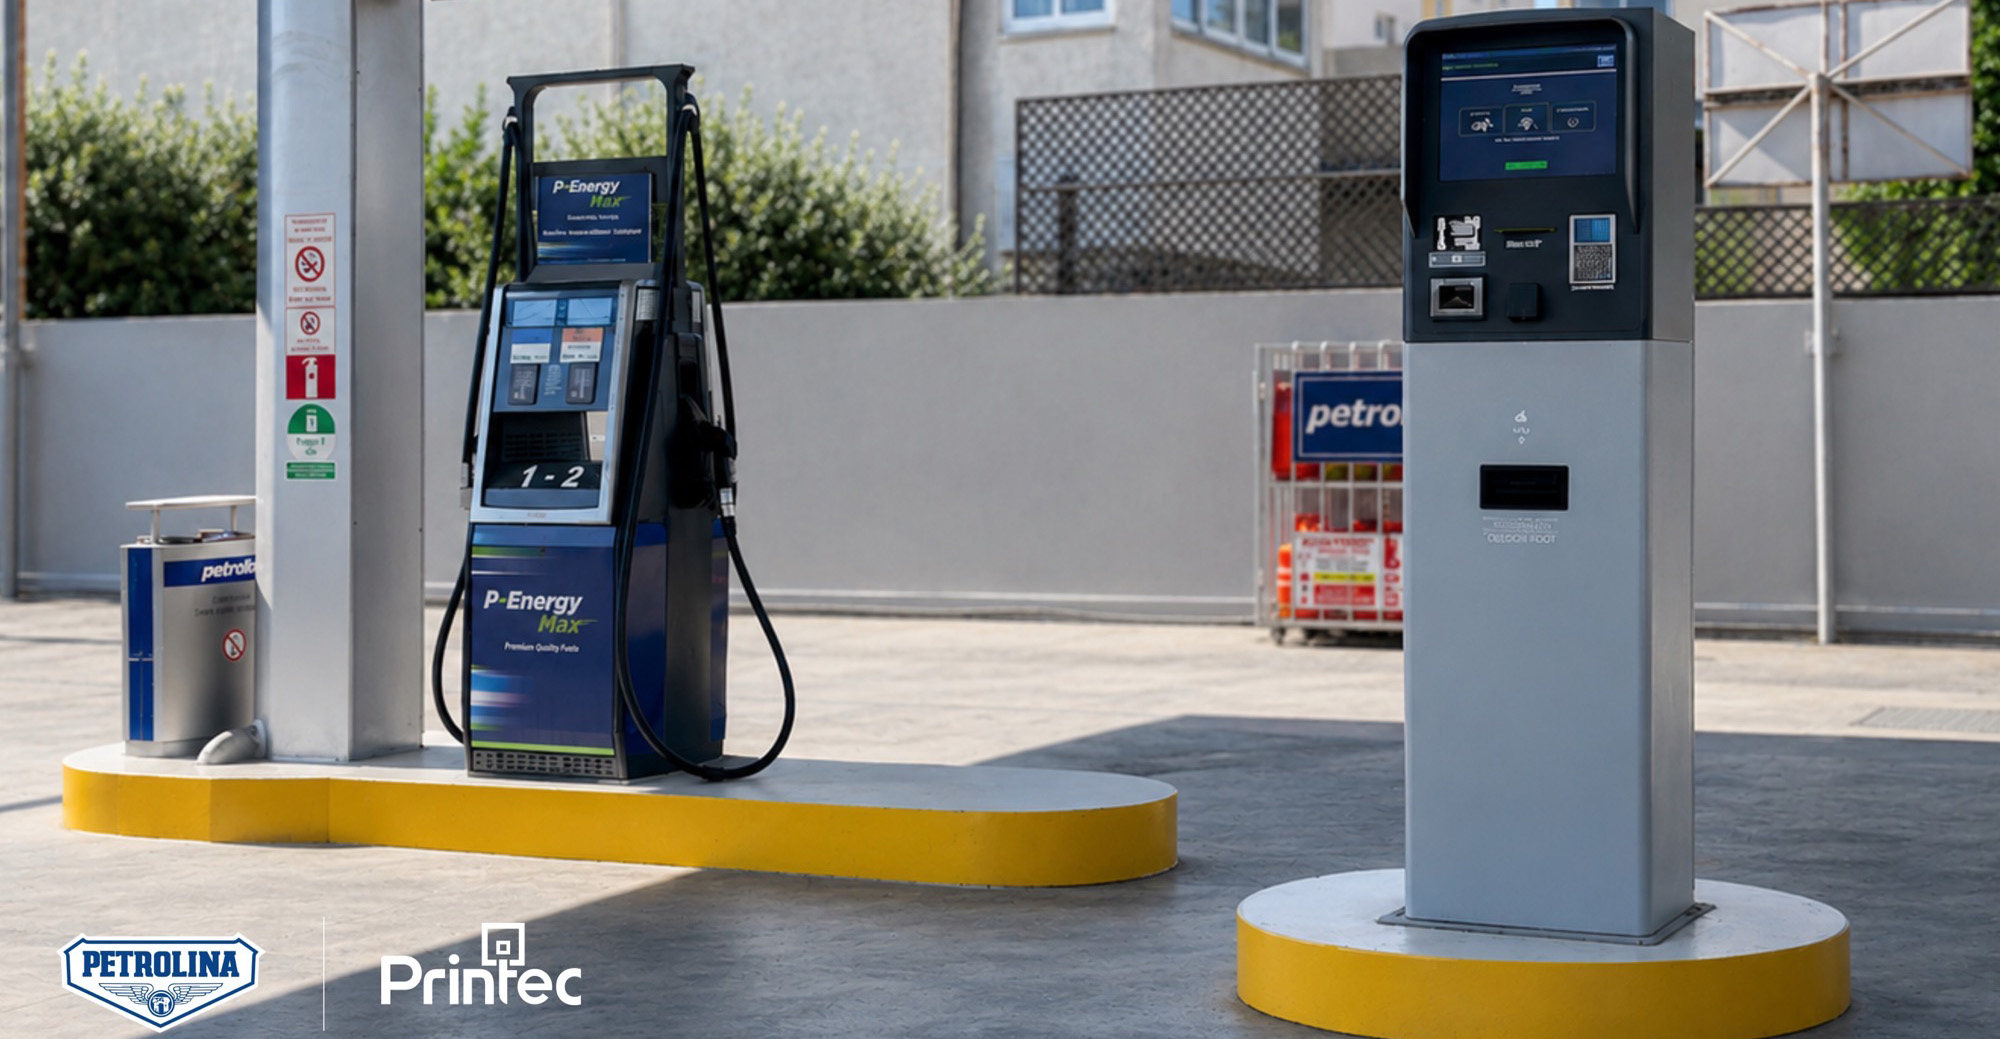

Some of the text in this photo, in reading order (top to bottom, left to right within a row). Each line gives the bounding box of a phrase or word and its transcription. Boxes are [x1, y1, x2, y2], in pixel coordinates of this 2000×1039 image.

[552, 179, 621, 195] P-Energy
[1305, 398, 1403, 435] petro
[521, 465, 538, 488] 1
[560, 465, 585, 488] 2
[483, 589, 583, 616] P-Energy
[537, 614, 584, 634] Max
[504, 641, 534, 652] Premium
[535, 642, 560, 654] Quality
